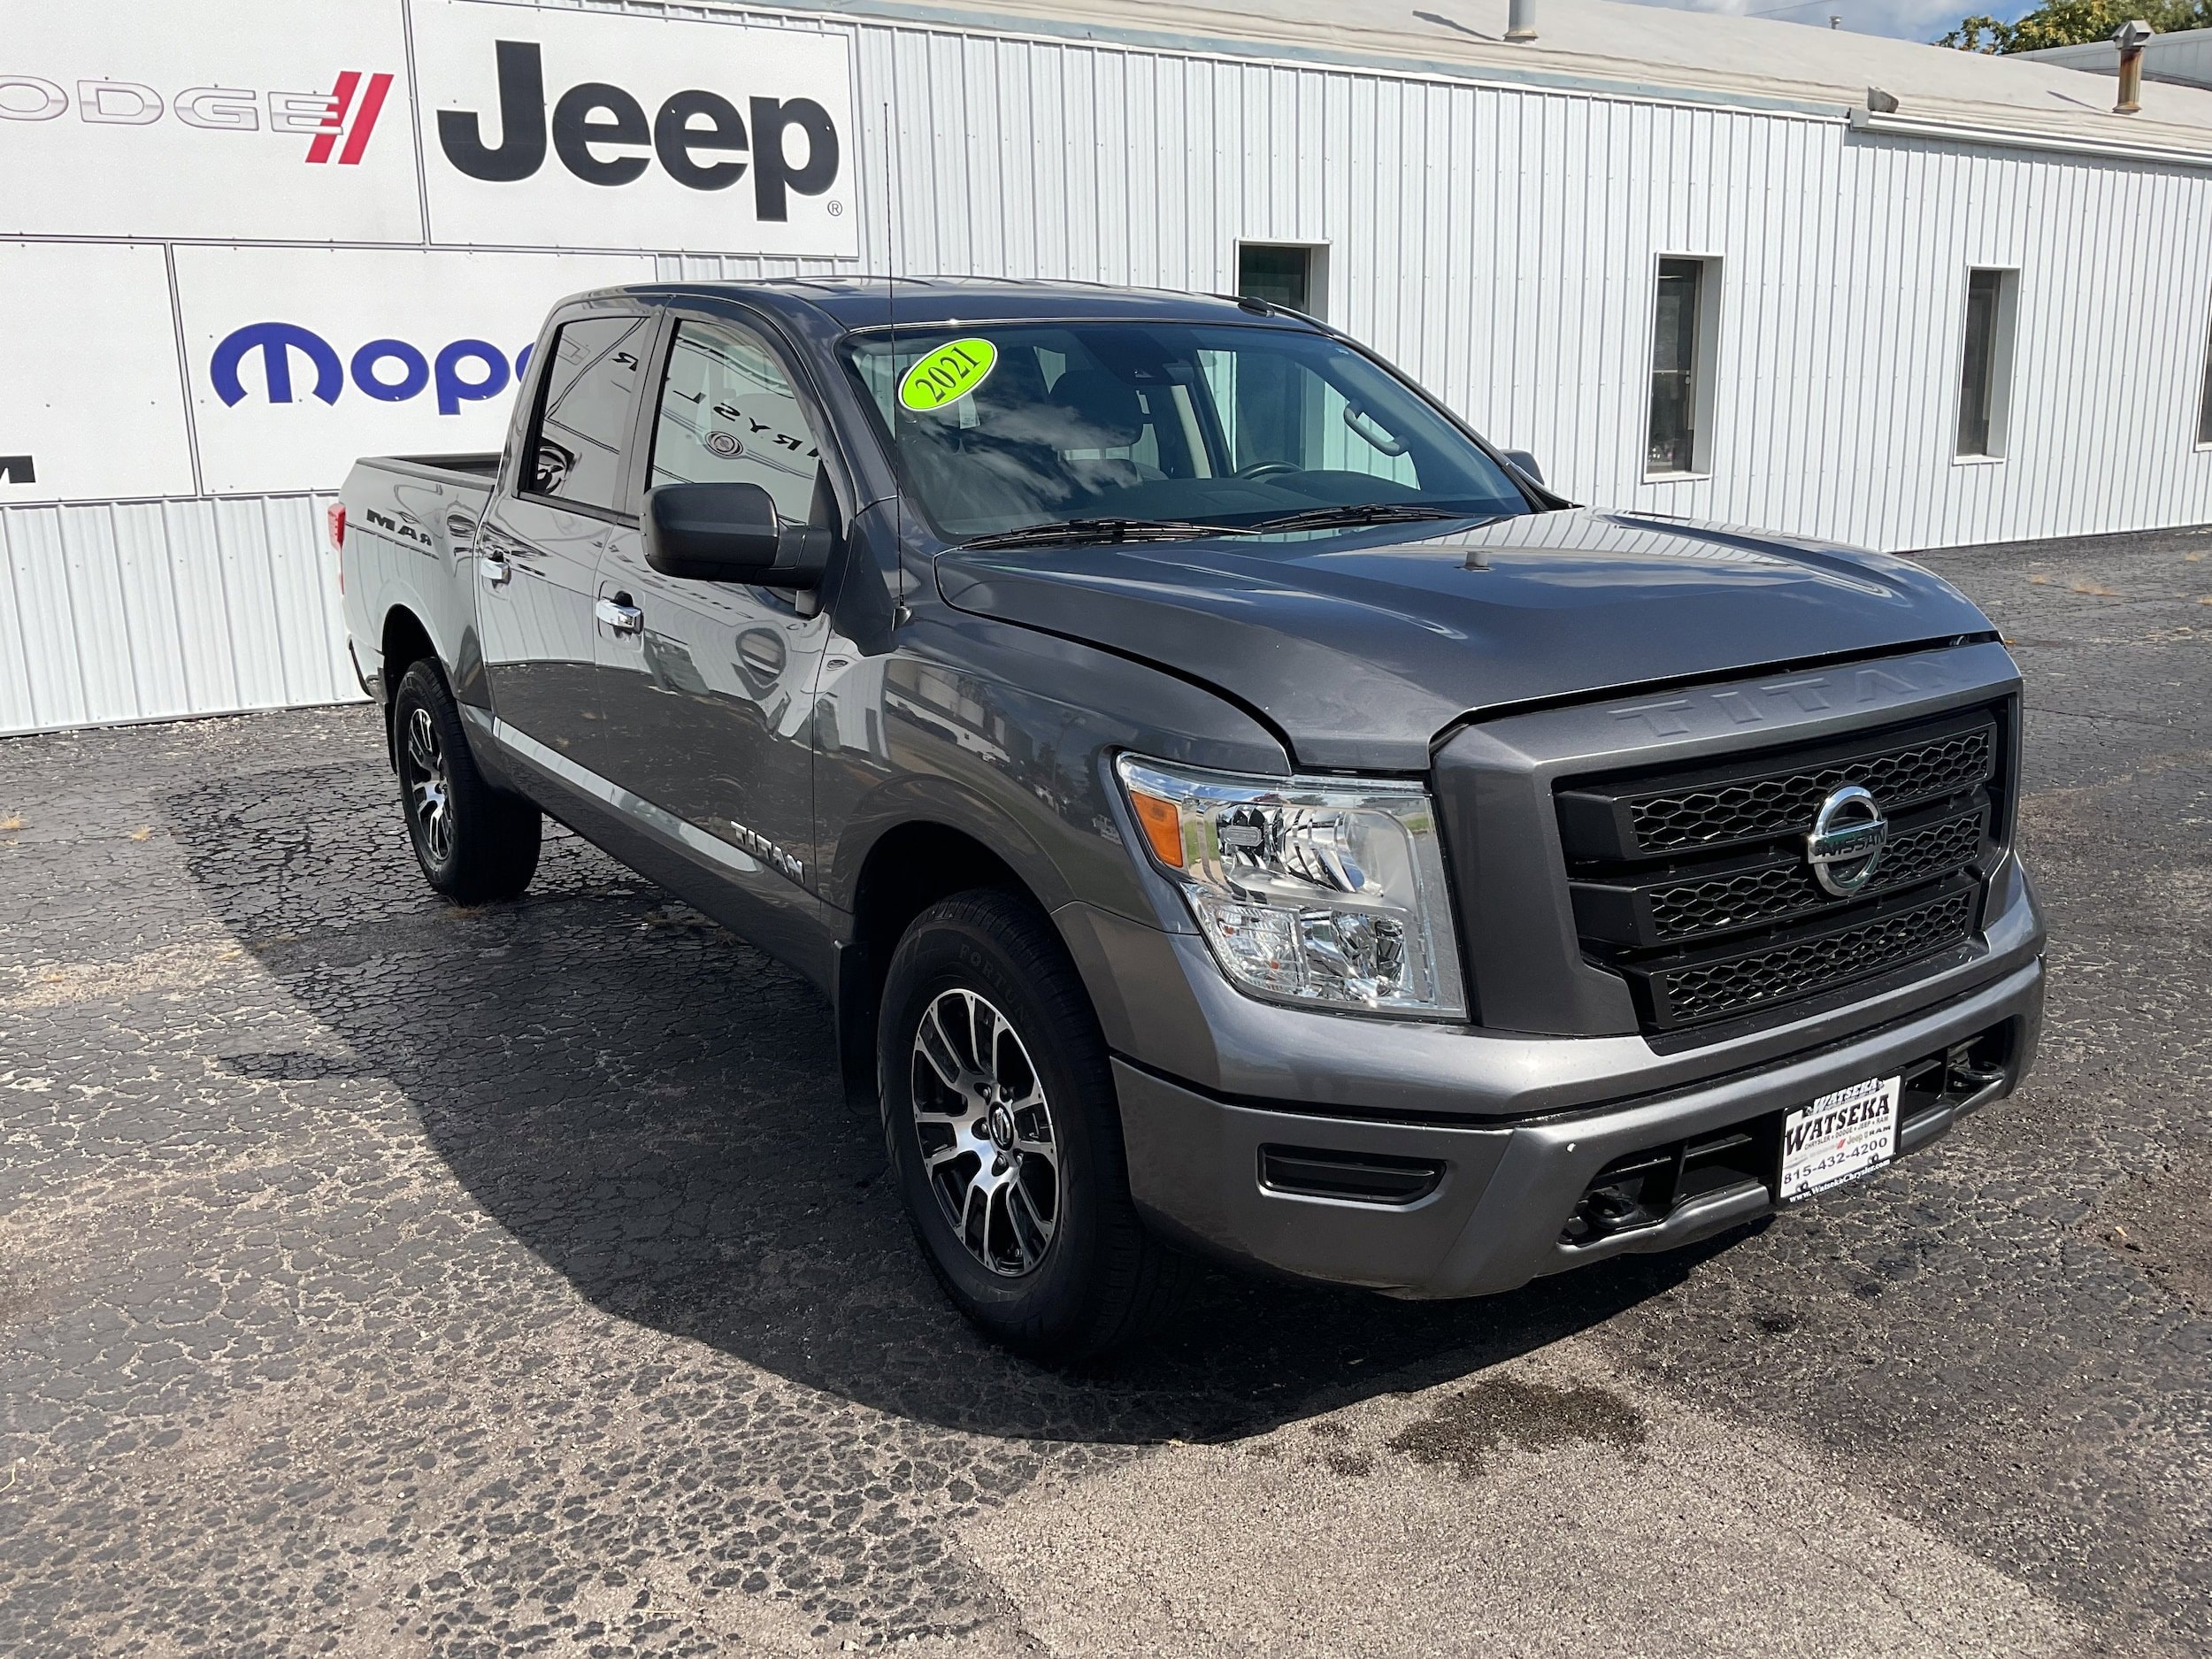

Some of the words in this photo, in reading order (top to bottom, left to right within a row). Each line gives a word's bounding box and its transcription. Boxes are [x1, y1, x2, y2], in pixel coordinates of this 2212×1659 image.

[437, 40, 840, 222] Jeep
[210, 322, 534, 415] Mop
[915, 346, 981, 403] 2021
[731, 821, 805, 885] TITAN
[1821, 824, 1886, 857] NISSAN
[1813, 1078, 1878, 1113] WATSEKA
[1785, 1094, 1890, 1156] WATSEKA
[1805, 1133, 1831, 1150] CHRYSLER
[1835, 1126, 1854, 1140] DODGE
[1858, 1121, 1871, 1133] JEEP
[1876, 1116, 1889, 1125] RAM
[1869, 1125, 1891, 1136] RAM
[1784, 1137, 1887, 1185] 815-432-4200
